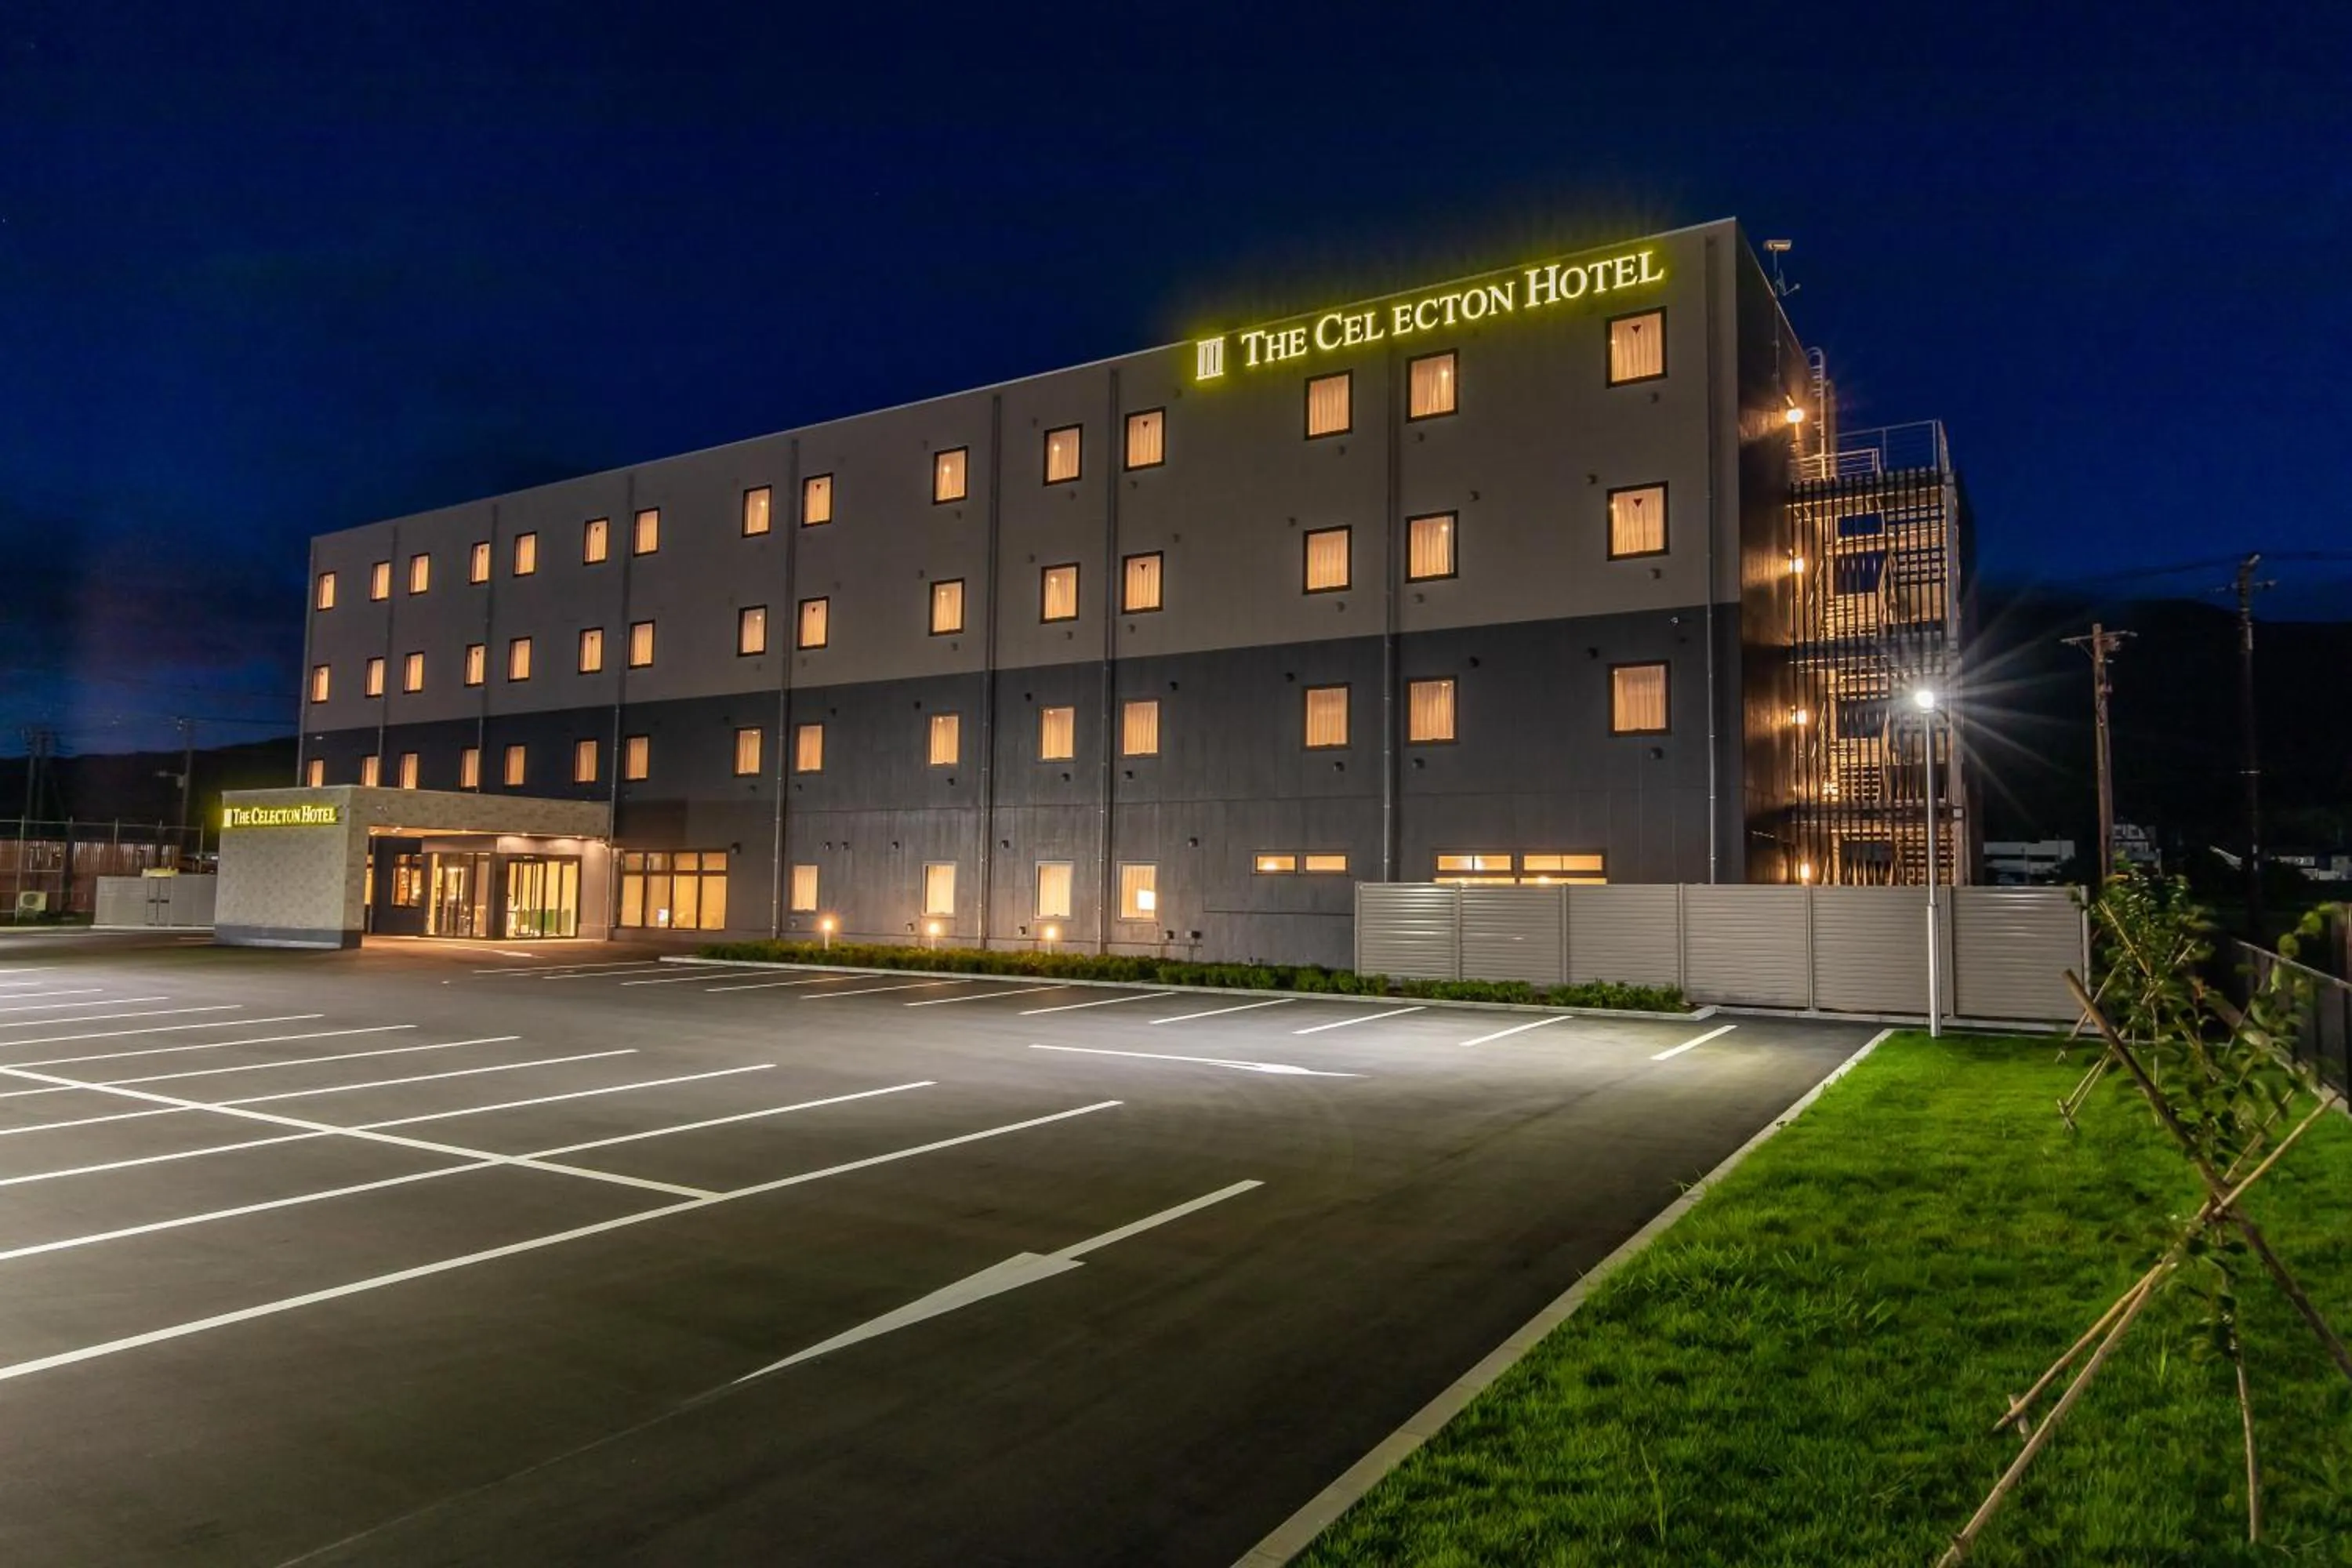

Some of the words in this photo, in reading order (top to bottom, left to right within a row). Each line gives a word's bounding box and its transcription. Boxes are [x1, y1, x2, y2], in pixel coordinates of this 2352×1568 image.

[1241, 328, 1307, 366] THE
[1524, 251, 1664, 307] HOTEL
[233, 808, 250, 824] THE
[251, 806, 301, 824] CELECTON
[301, 804, 336, 822] HOTEL
